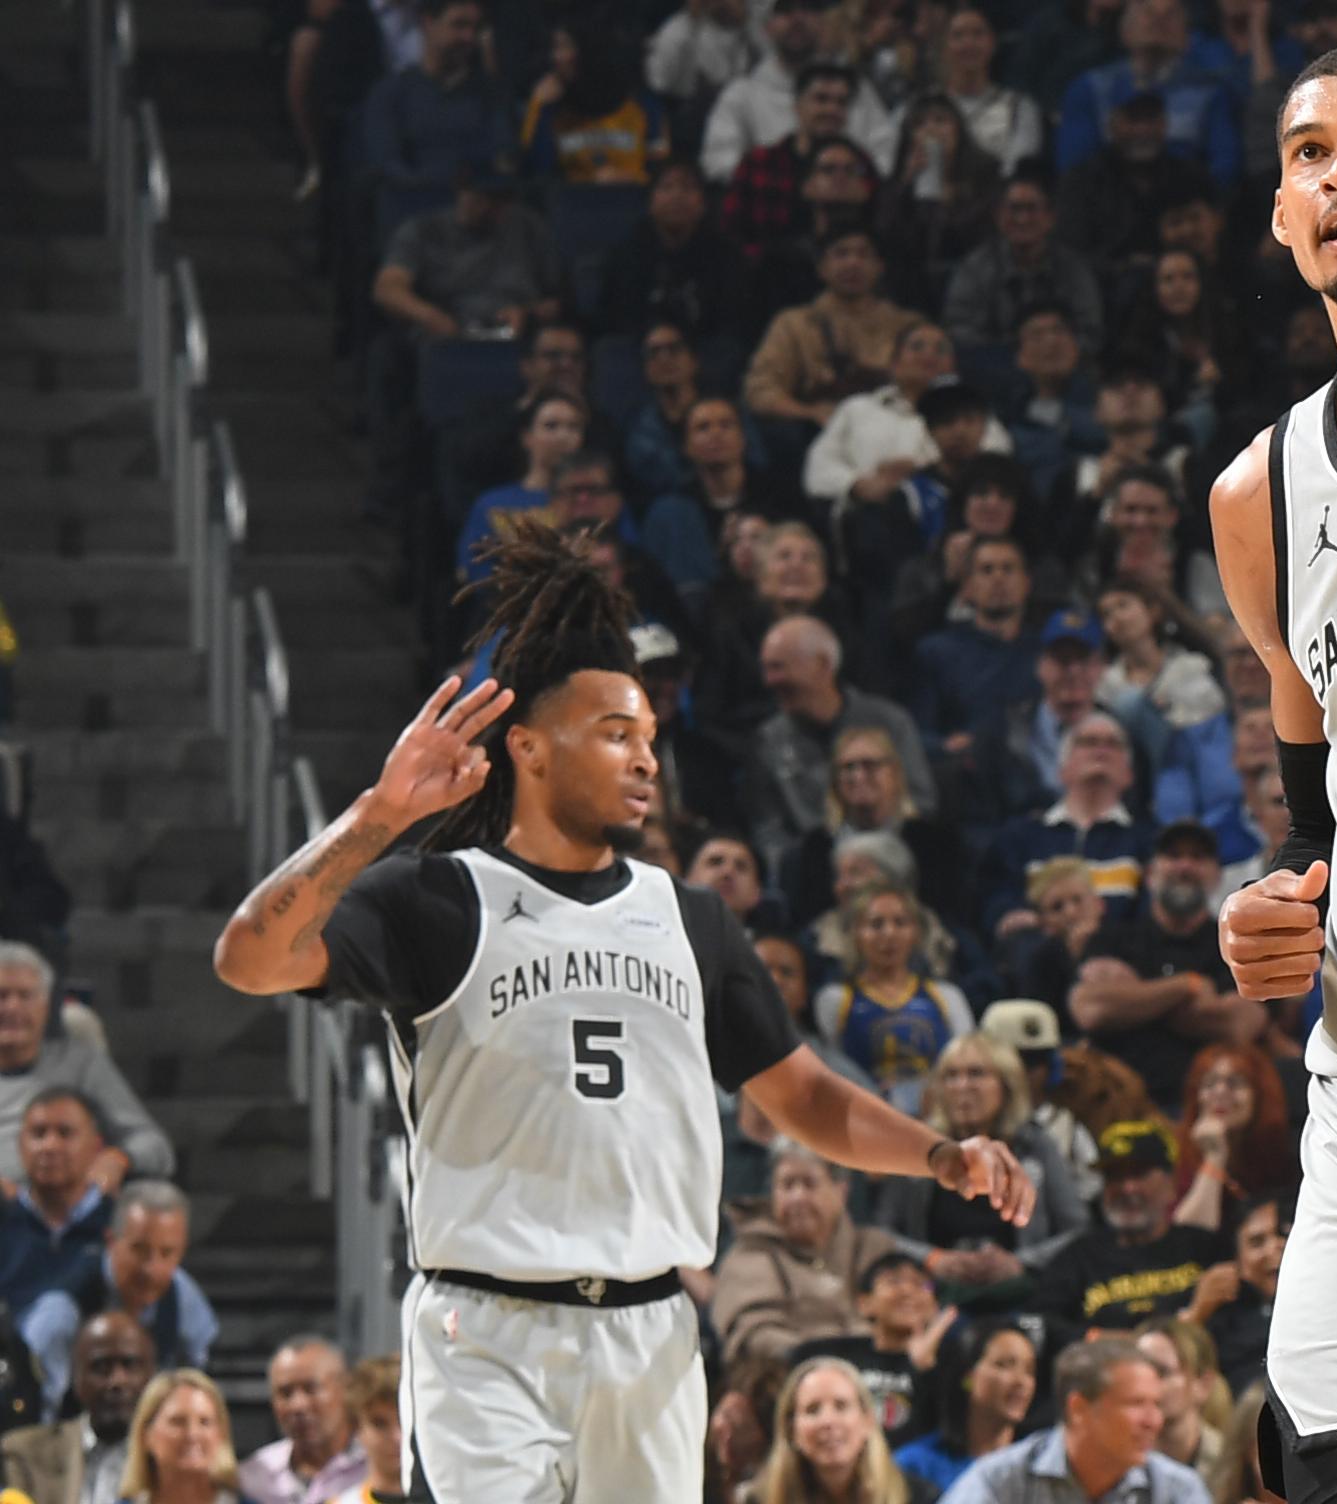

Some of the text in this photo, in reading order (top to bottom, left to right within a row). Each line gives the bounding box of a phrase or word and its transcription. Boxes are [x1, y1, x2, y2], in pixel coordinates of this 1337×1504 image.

[490, 950, 691, 1022] SAN ANTONIO
[570, 1016, 628, 1103] 5
